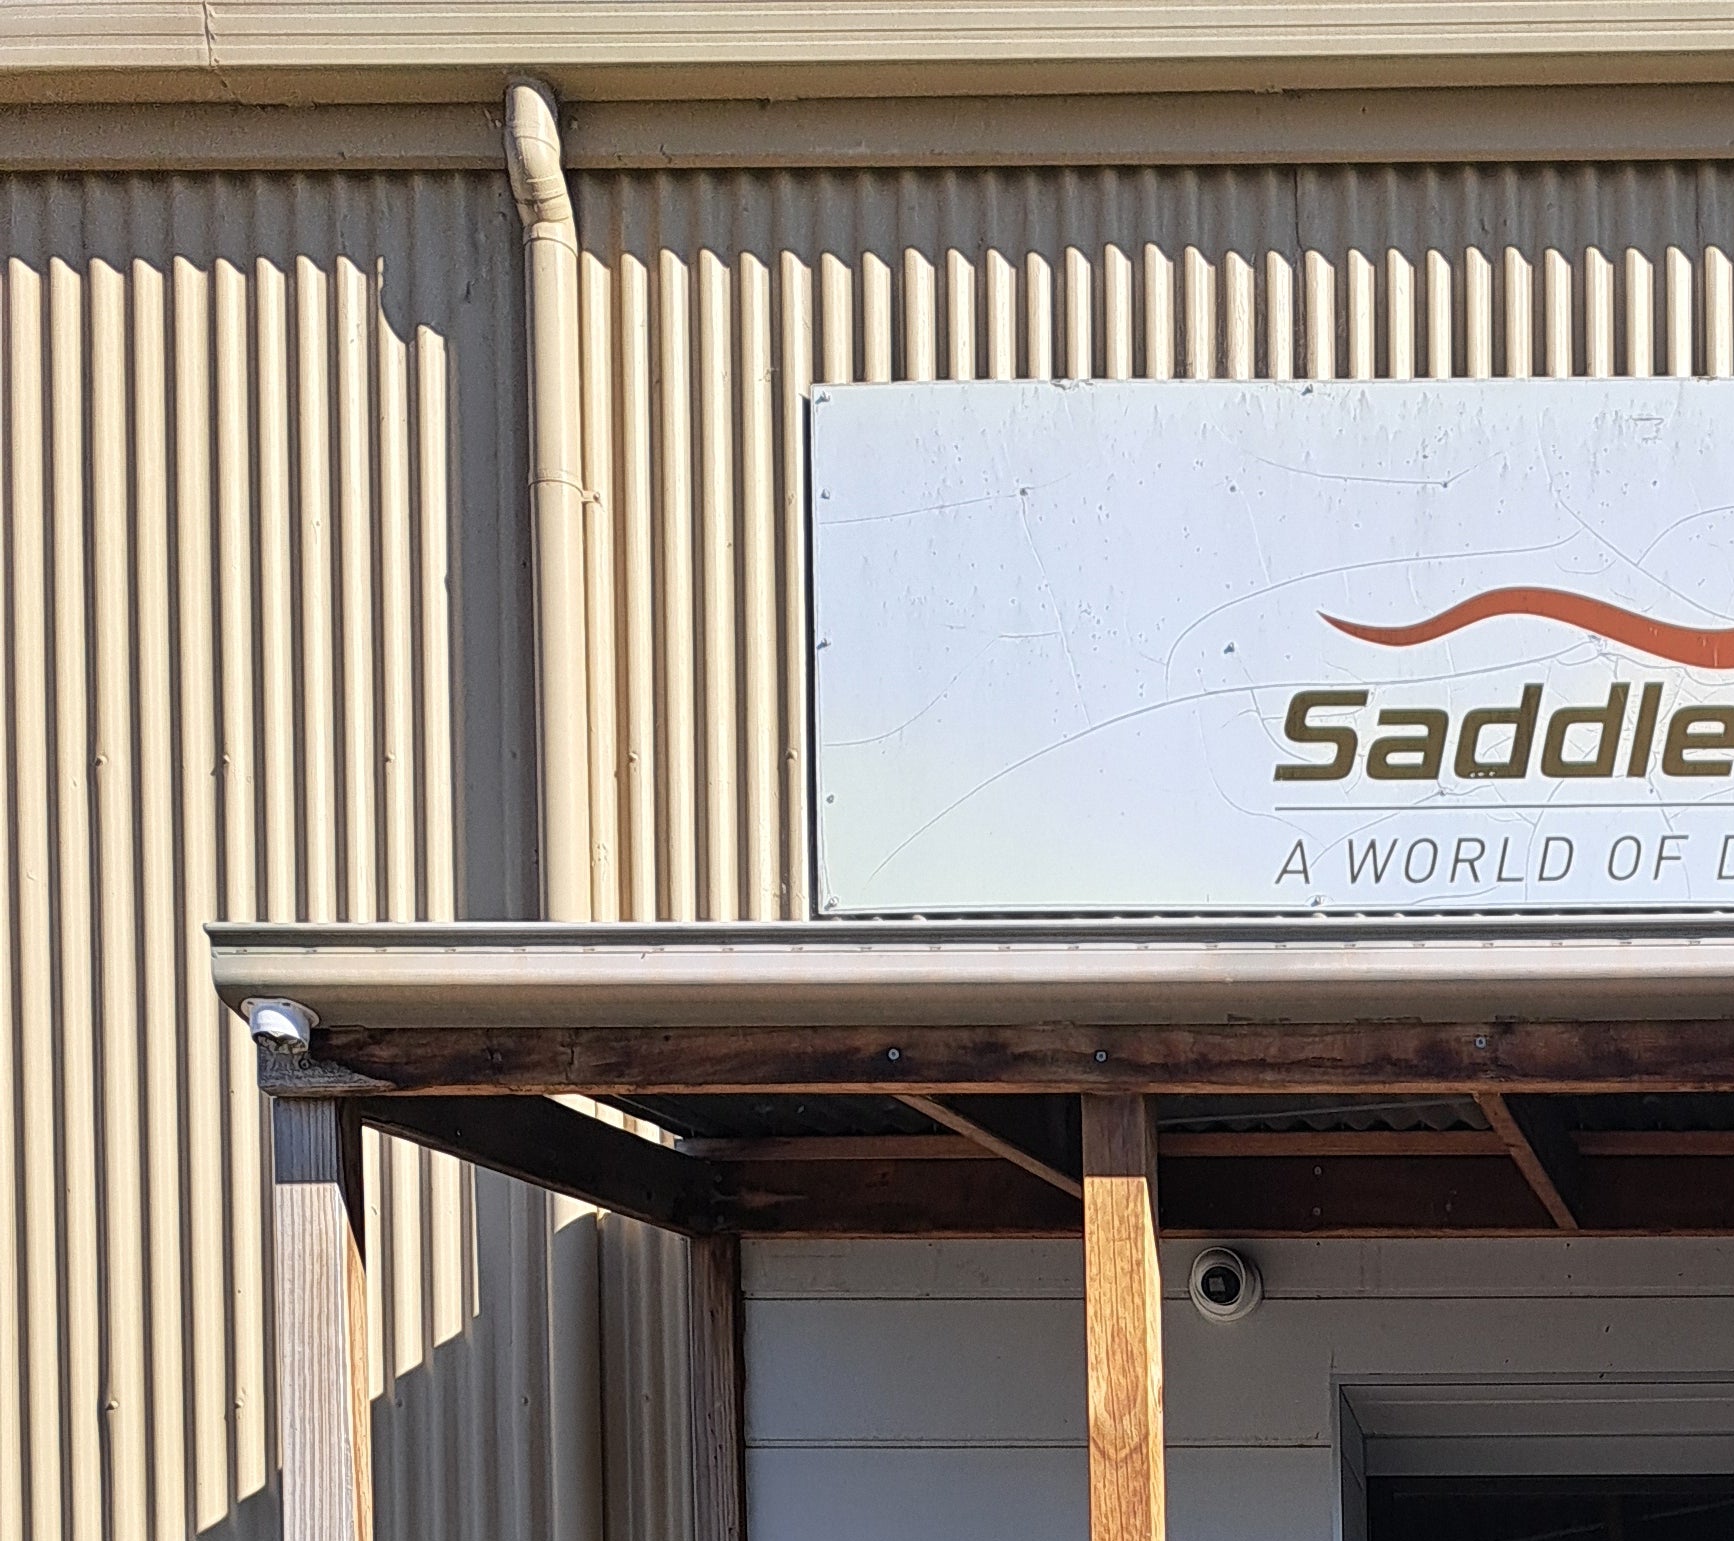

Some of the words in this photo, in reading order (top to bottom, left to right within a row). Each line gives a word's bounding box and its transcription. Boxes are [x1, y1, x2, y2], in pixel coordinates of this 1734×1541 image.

[1275, 838, 1313, 886] A
[1345, 836, 1577, 885] WORLD
[1606, 834, 1690, 881] OF
